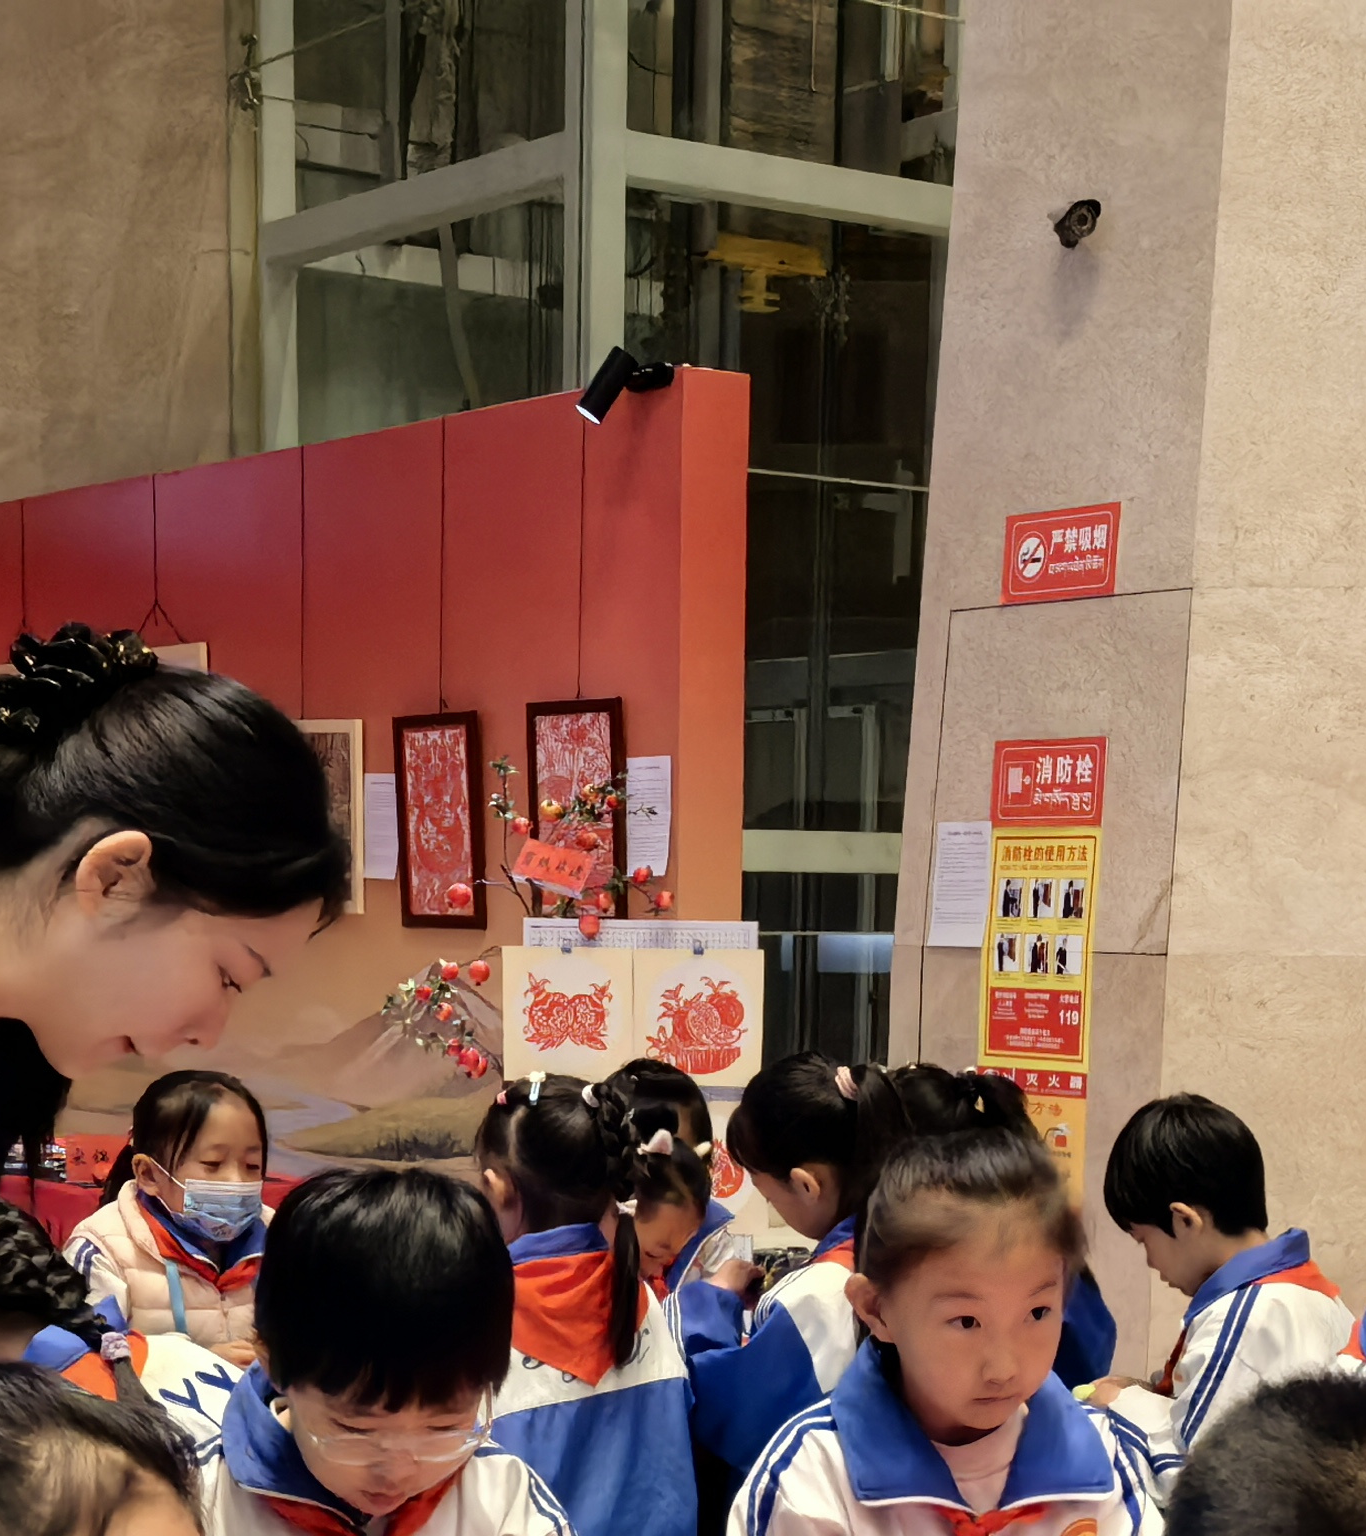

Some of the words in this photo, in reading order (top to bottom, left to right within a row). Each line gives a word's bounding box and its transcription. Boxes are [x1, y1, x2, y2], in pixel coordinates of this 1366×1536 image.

[1049, 524, 1108, 555] 严禁吸烟
[1036, 754, 1093, 785] 消防栓
[1059, 1009, 1079, 1025] 119
